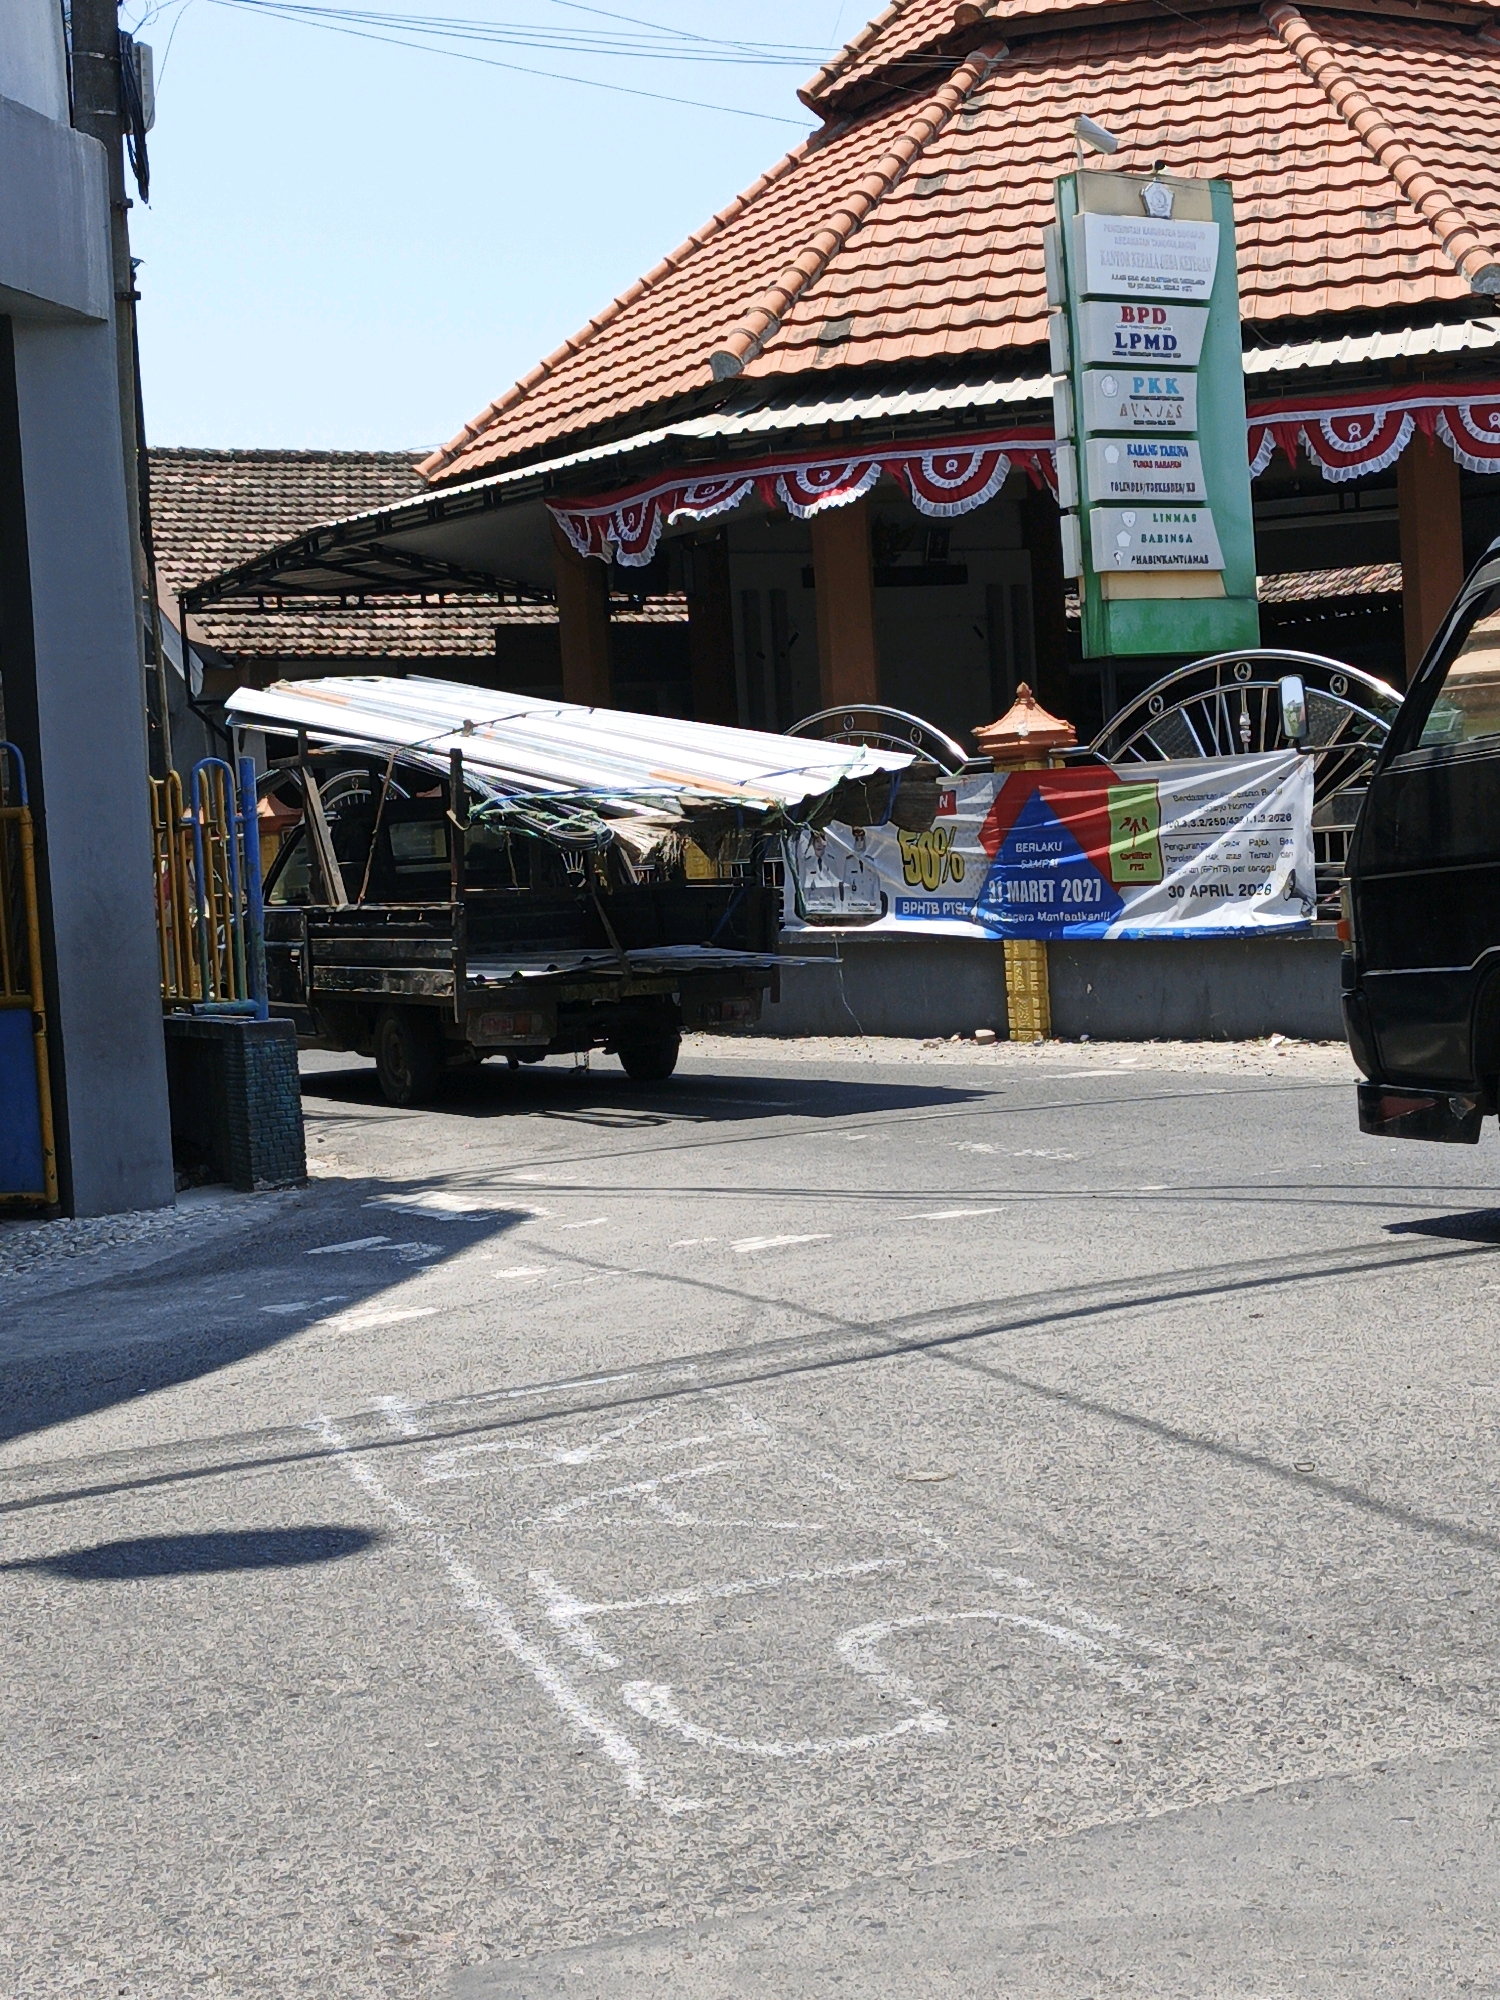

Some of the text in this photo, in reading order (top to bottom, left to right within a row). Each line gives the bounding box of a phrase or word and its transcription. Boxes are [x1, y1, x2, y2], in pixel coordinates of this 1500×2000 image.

[1100, 249, 1130, 267] KANTOR
[1121, 306, 1167, 324] BPD
[1114, 332, 1177, 350] LPMD
[1133, 377, 1179, 394] PKK
[1127, 444, 1188, 457] KARANG TARUNA
[1153, 513, 1197, 523] LINMAS
[1141, 533, 1193, 543] BABINSA
[1015, 841, 1063, 853] BERLAKU
[897, 825, 966, 892] 50%
[1249, 851, 1274, 860] Tanah
[1020, 858, 1060, 869] SAMPAI
[1232, 865, 1246, 875] per
[987, 878, 1102, 904] 31 MARET 2027
[1168, 883, 1272, 899] 30 APRIL 2026
[902, 901, 969, 916] BPHTB PTSL
